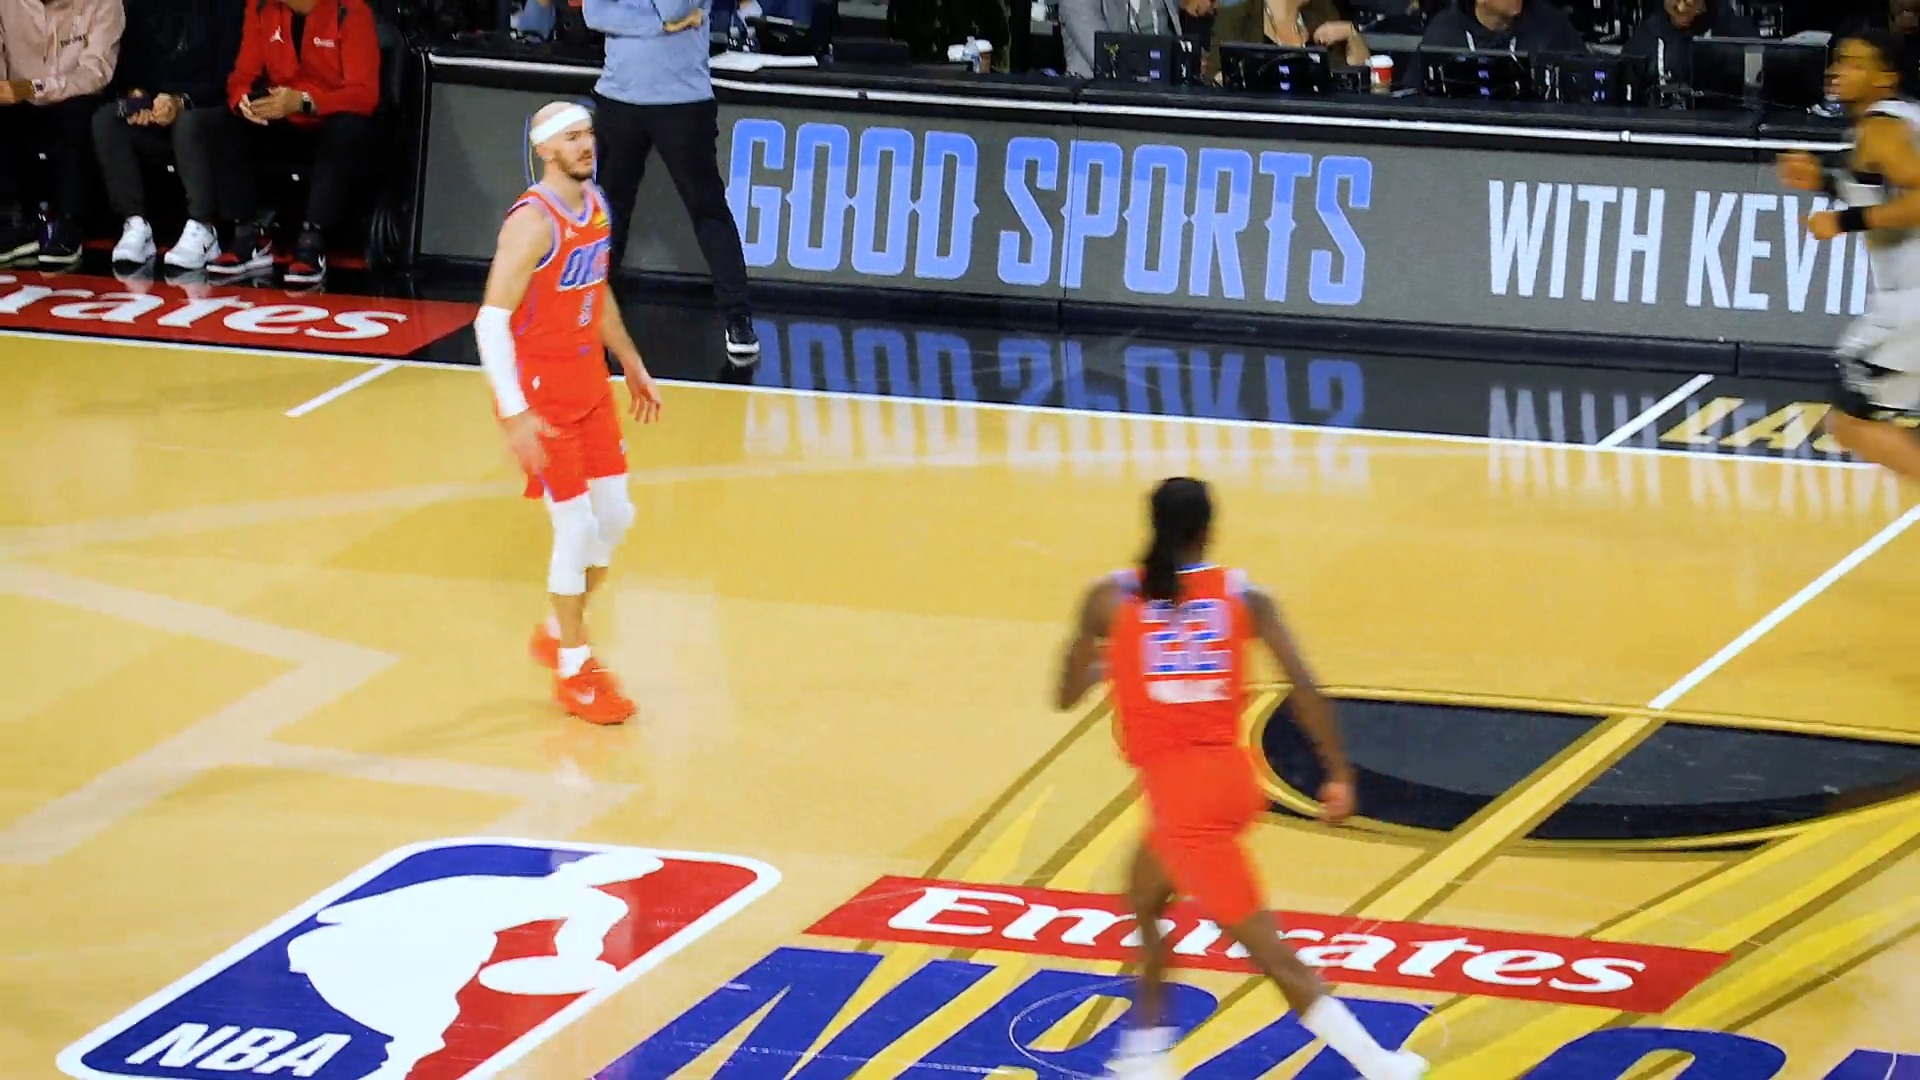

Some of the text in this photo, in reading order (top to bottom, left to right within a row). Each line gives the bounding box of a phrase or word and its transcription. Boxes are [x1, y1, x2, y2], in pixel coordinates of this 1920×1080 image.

[726, 118, 980, 280] GOOD
[998, 136, 1373, 306] SPORTS
[1488, 179, 1665, 305] WITH
[0, 274, 408, 341] rates
[1659, 396, 1851, 453] LA
[125, 1022, 352, 1077] NBA
